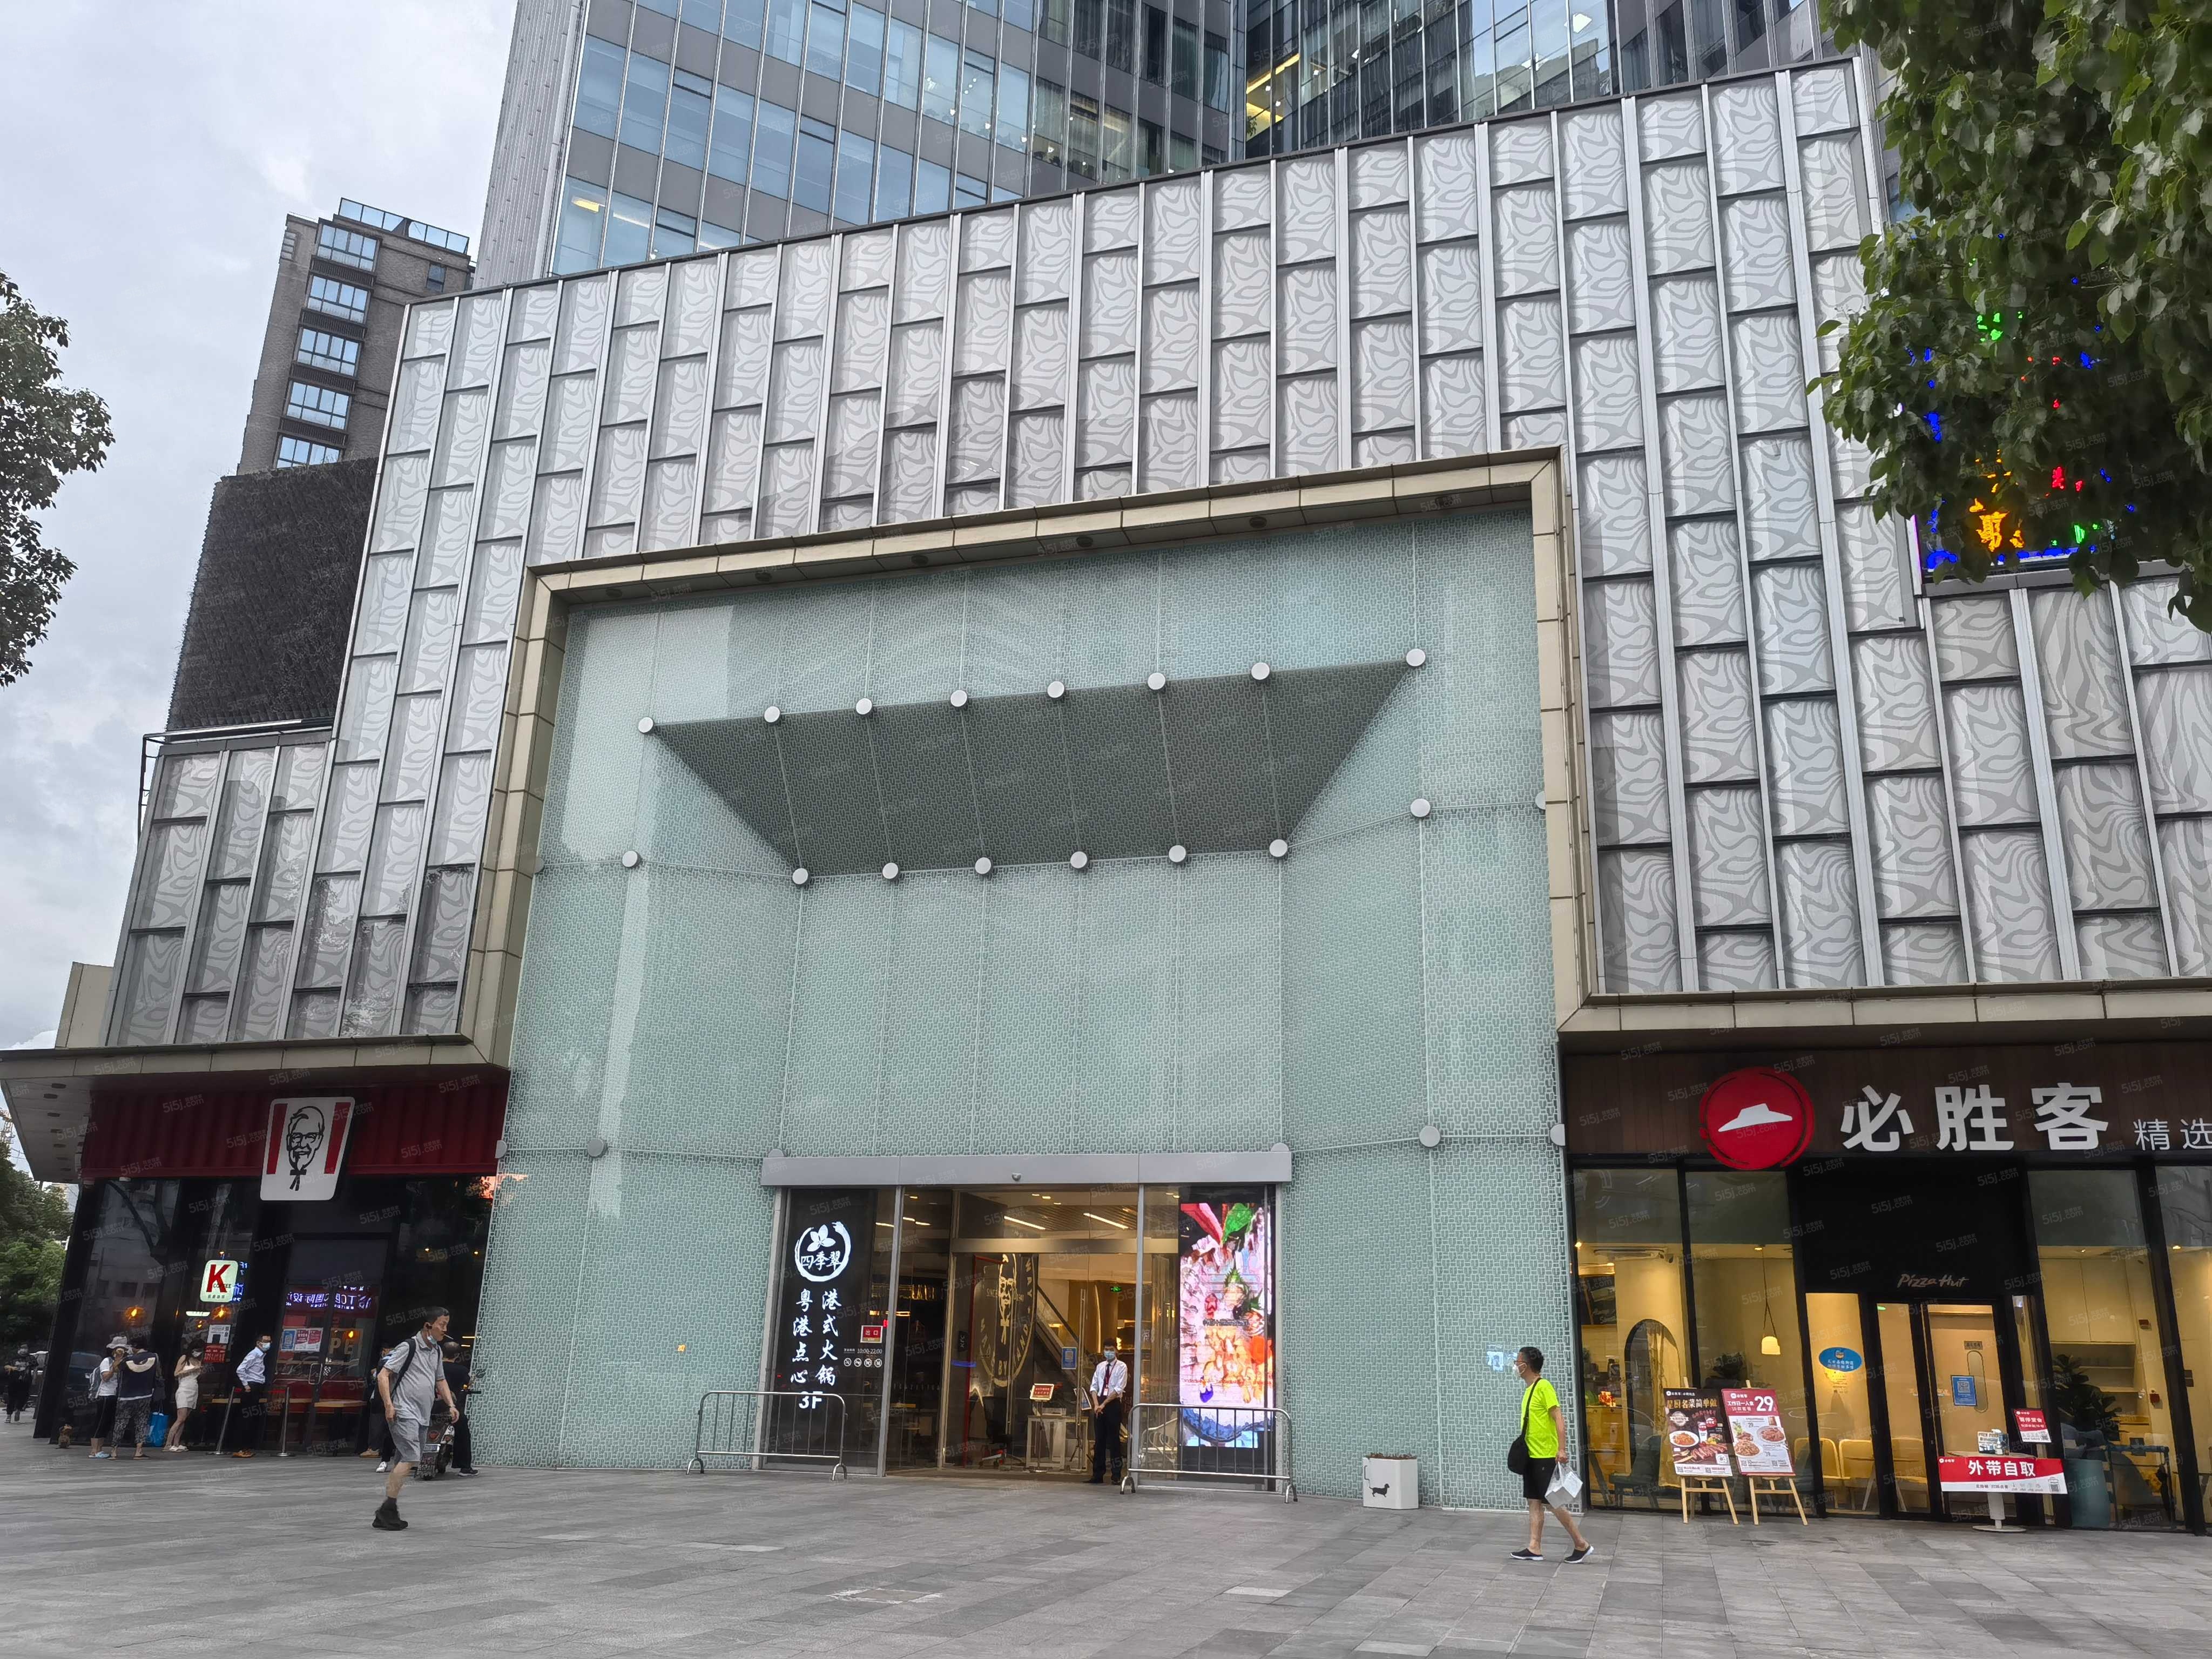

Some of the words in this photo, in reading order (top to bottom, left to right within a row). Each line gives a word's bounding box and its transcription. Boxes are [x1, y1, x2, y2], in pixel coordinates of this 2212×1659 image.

[1840, 1082, 2109, 1152] 必胜客
[2133, 1118, 2212, 1151] 精选
[800, 1250, 842, 1271] 四季翠
[206, 1264, 231, 1292] K
[1897, 1273, 1937, 1288] Pizza
[1938, 1274, 1970, 1287] Hut
[815, 1288, 842, 1386] 港式火锅
[798, 1391, 823, 1409] 3F
[1754, 1396, 1773, 1412] 29
[1967, 1459, 2036, 1477] 外带自取
